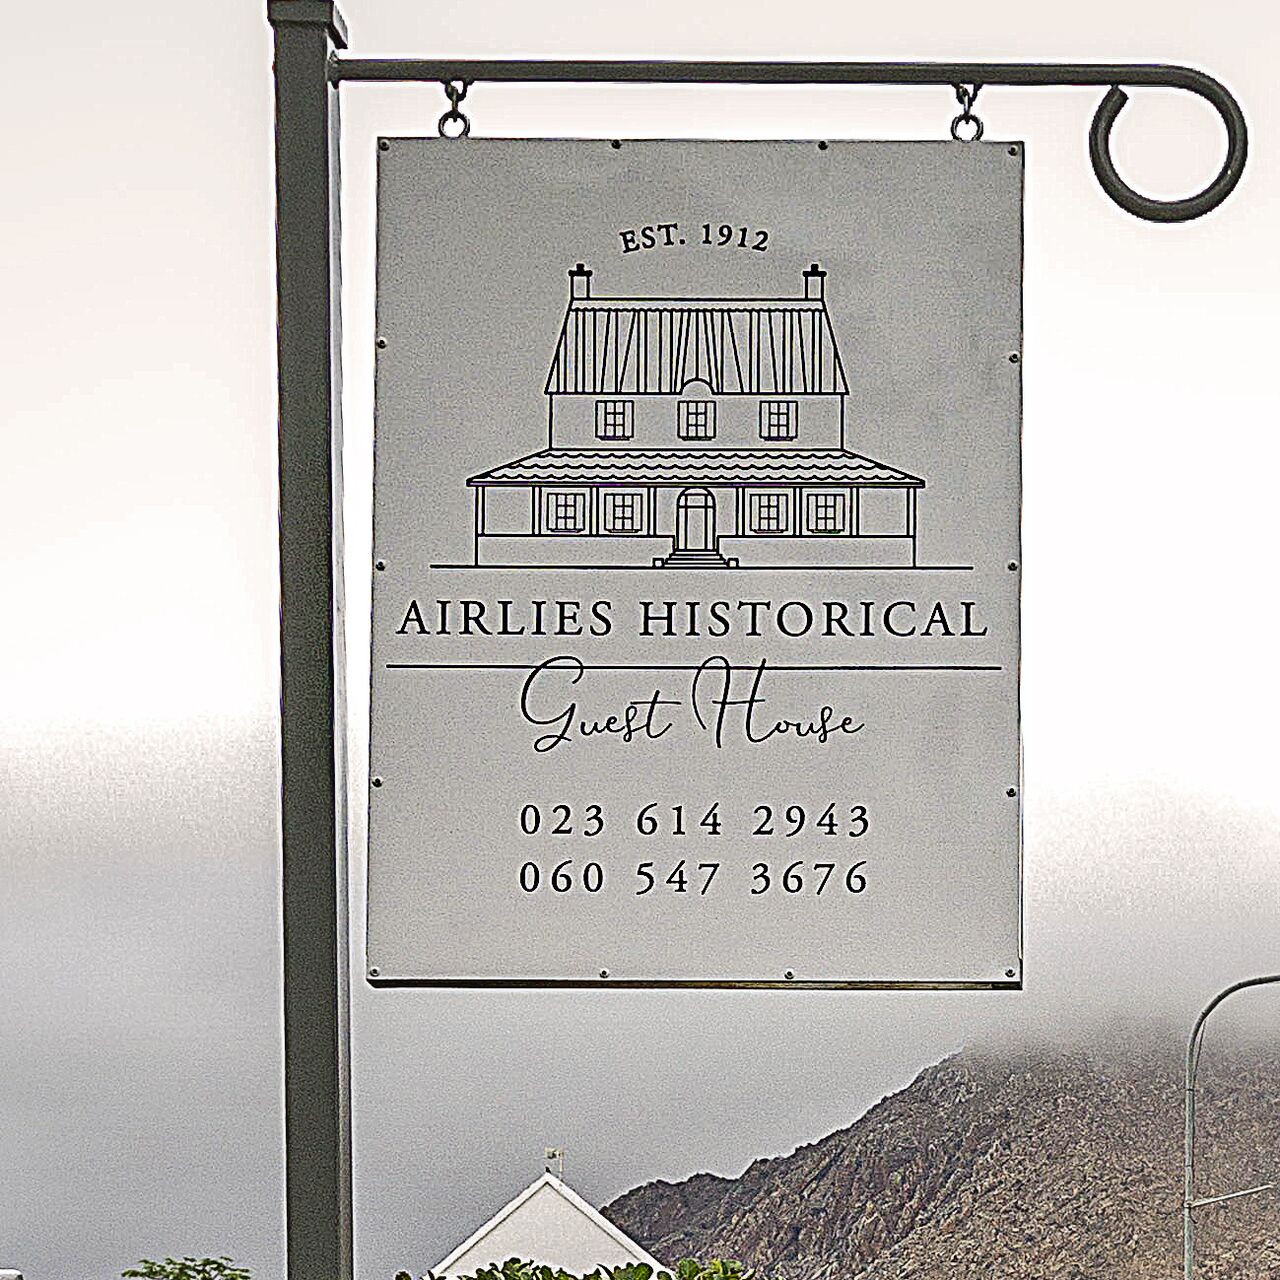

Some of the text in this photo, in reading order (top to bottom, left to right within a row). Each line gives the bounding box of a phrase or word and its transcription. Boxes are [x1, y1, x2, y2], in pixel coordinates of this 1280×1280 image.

[619, 223, 769, 253] EST. 1912
[396, 600, 988, 638] AIRLIES HISTORICAL
[520, 656, 865, 753] Guest House
[520, 803, 869, 838] 023 614 2943
[520, 860, 867, 896] 060 547 3676
